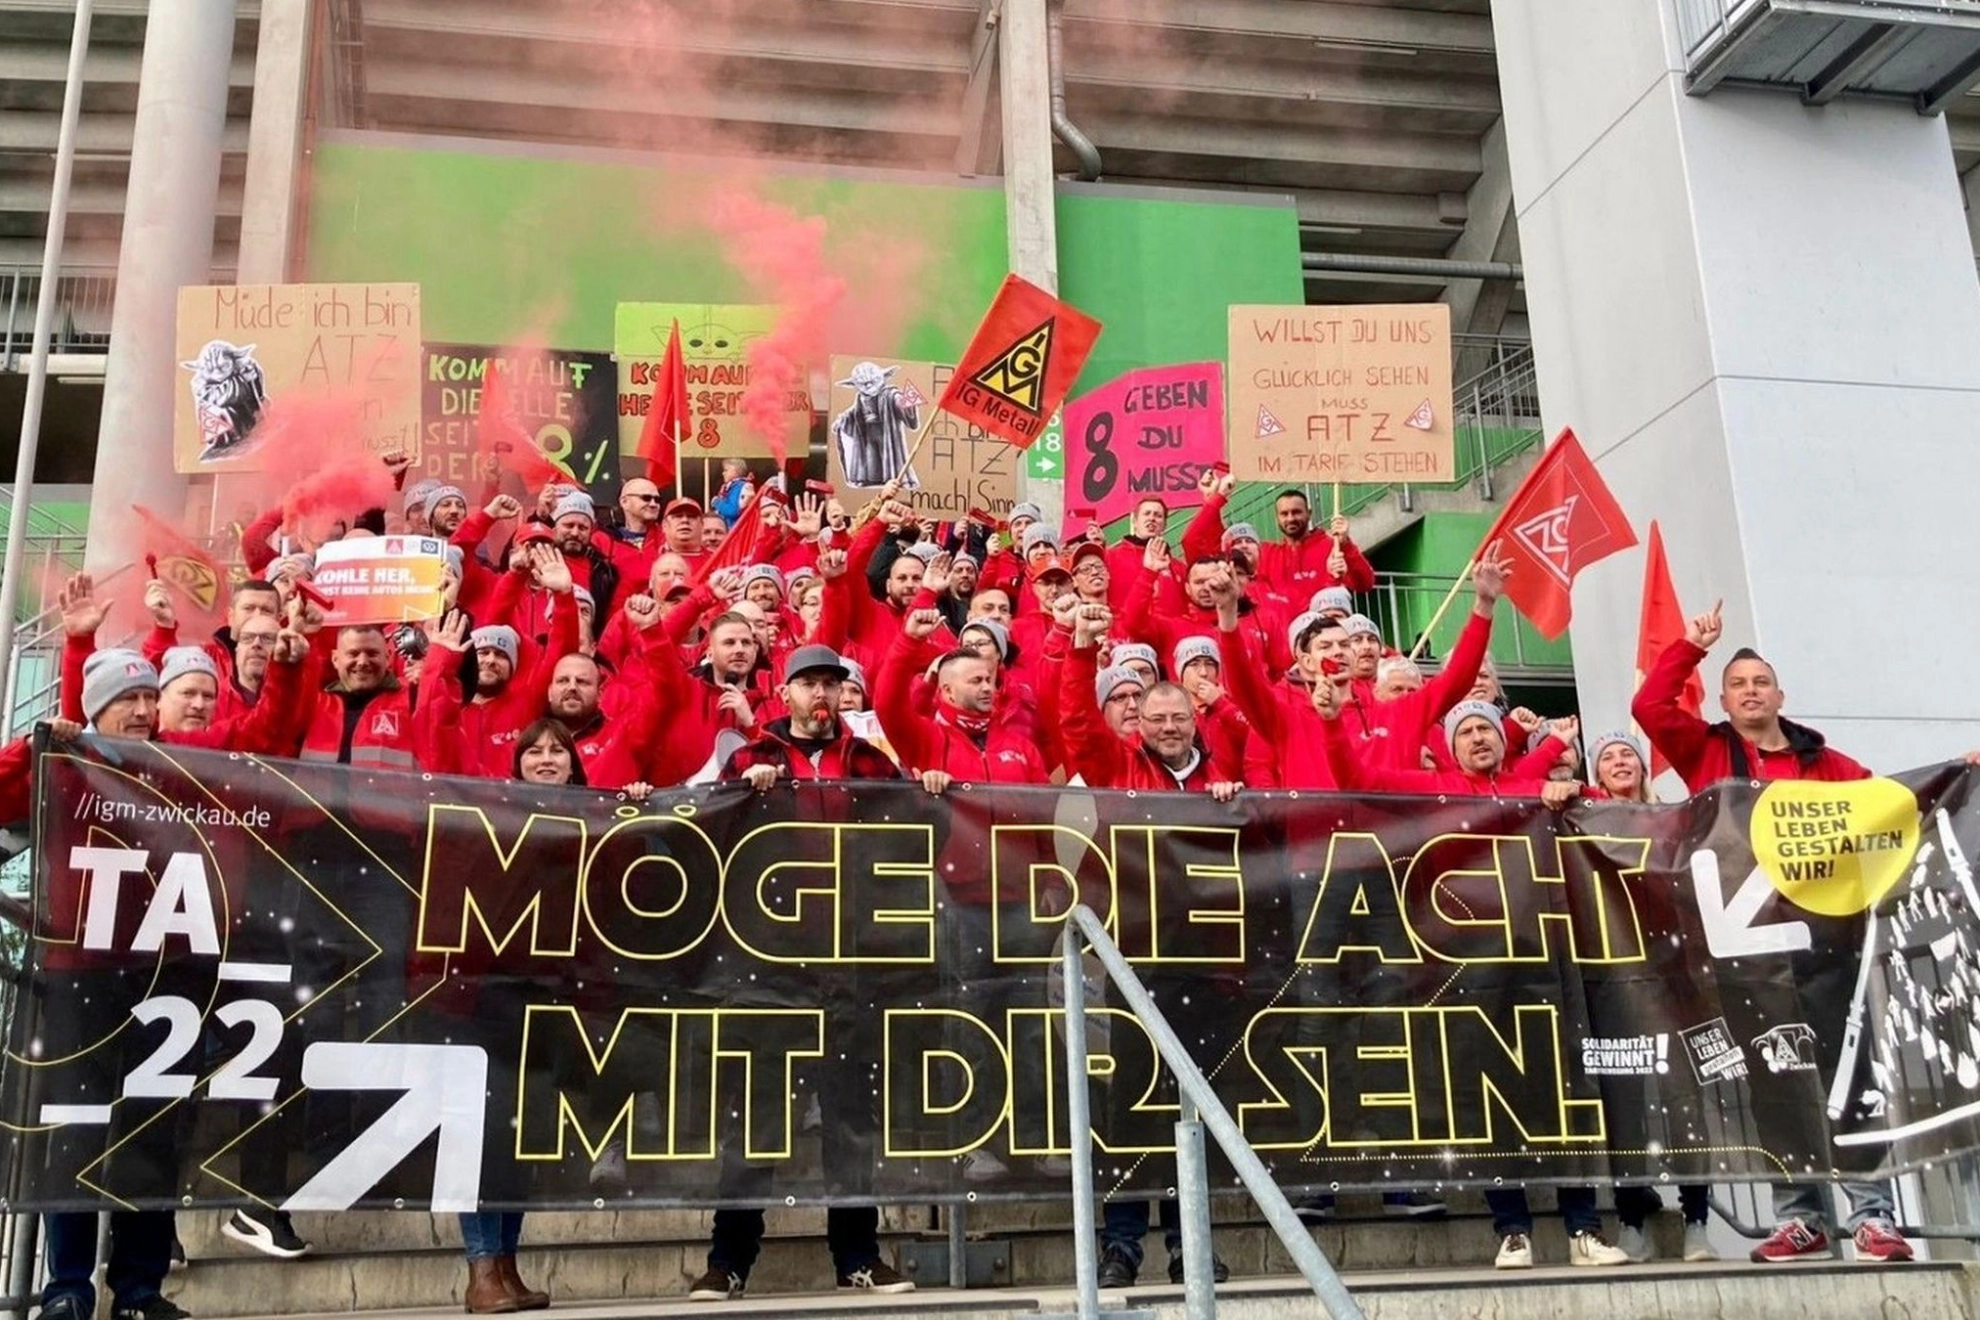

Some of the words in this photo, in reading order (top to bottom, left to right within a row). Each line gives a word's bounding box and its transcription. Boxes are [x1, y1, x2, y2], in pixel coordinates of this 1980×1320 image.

[215, 286, 293, 330] Müde
[313, 288, 350, 328] ich
[364, 286, 411, 327] bin
[1253, 319, 1342, 343] WILLST
[1351, 319, 1378, 342] DU
[1390, 320, 1432, 343] UNS
[301, 333, 399, 386] ATZ
[1253, 361, 1352, 389] GLÜCKLICH
[1366, 366, 1429, 386] SEHEN
[956, 383, 980, 408] IG
[981, 395, 1040, 436] Metall
[1125, 380, 1207, 413] GEBEN
[1321, 398, 1369, 410] MUSS
[697, 418, 720, 448] 8
[1138, 426, 1182, 449] DU
[1307, 413, 1396, 441] ATZ
[933, 437, 1010, 475] ATZ
[1083, 412, 1118, 502] 8
[1258, 456, 1281, 472] IM
[1292, 452, 1350, 472] TARIF
[1364, 452, 1438, 473] STEHEN
[74, 793, 271, 828] //igm-zwickau.de
[1771, 800, 1852, 818] UNSER
[1774, 818, 1848, 838] LEBEN
[1777, 830, 1903, 858] GESTALTEN
[416, 804, 935, 962] MÖGE
[991, 824, 1245, 964] DIE
[1295, 832, 1652, 964] ACHT
[1779, 860, 1834, 881] WIR!
[69, 846, 220, 955] TA
[122, 995, 284, 1099] 22
[1582, 1035, 1654, 1050] SOLIDARITÄT
[1689, 1027, 1724, 1048] UNSER
[1696, 1040, 1729, 1060] LEBEN
[515, 1004, 825, 1160] MIT
[884, 1008, 1180, 1158] DIR
[1238, 1004, 1606, 1150] SEIN.
[1721, 1062, 1749, 1080] WIR!
